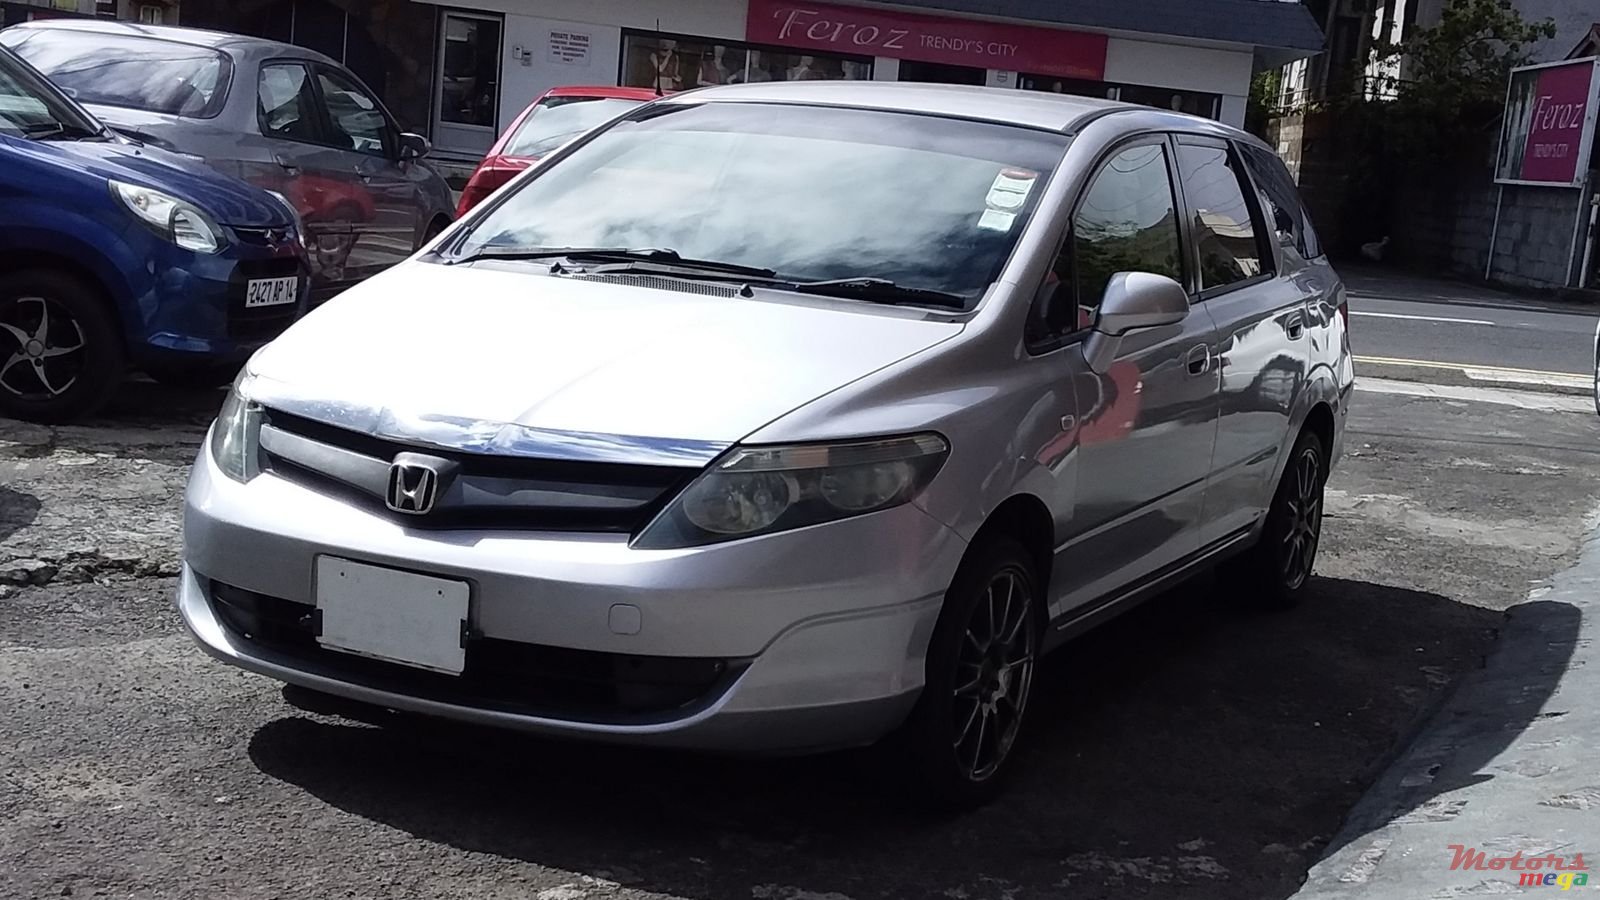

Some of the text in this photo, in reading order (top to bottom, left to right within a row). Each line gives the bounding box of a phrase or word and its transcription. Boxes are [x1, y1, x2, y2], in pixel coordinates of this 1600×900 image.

[773, 9, 1018, 56] Feroz TRENDY'S CITY
[1531, 95, 1583, 134] Feroz
[250, 281, 273, 303] 2427
